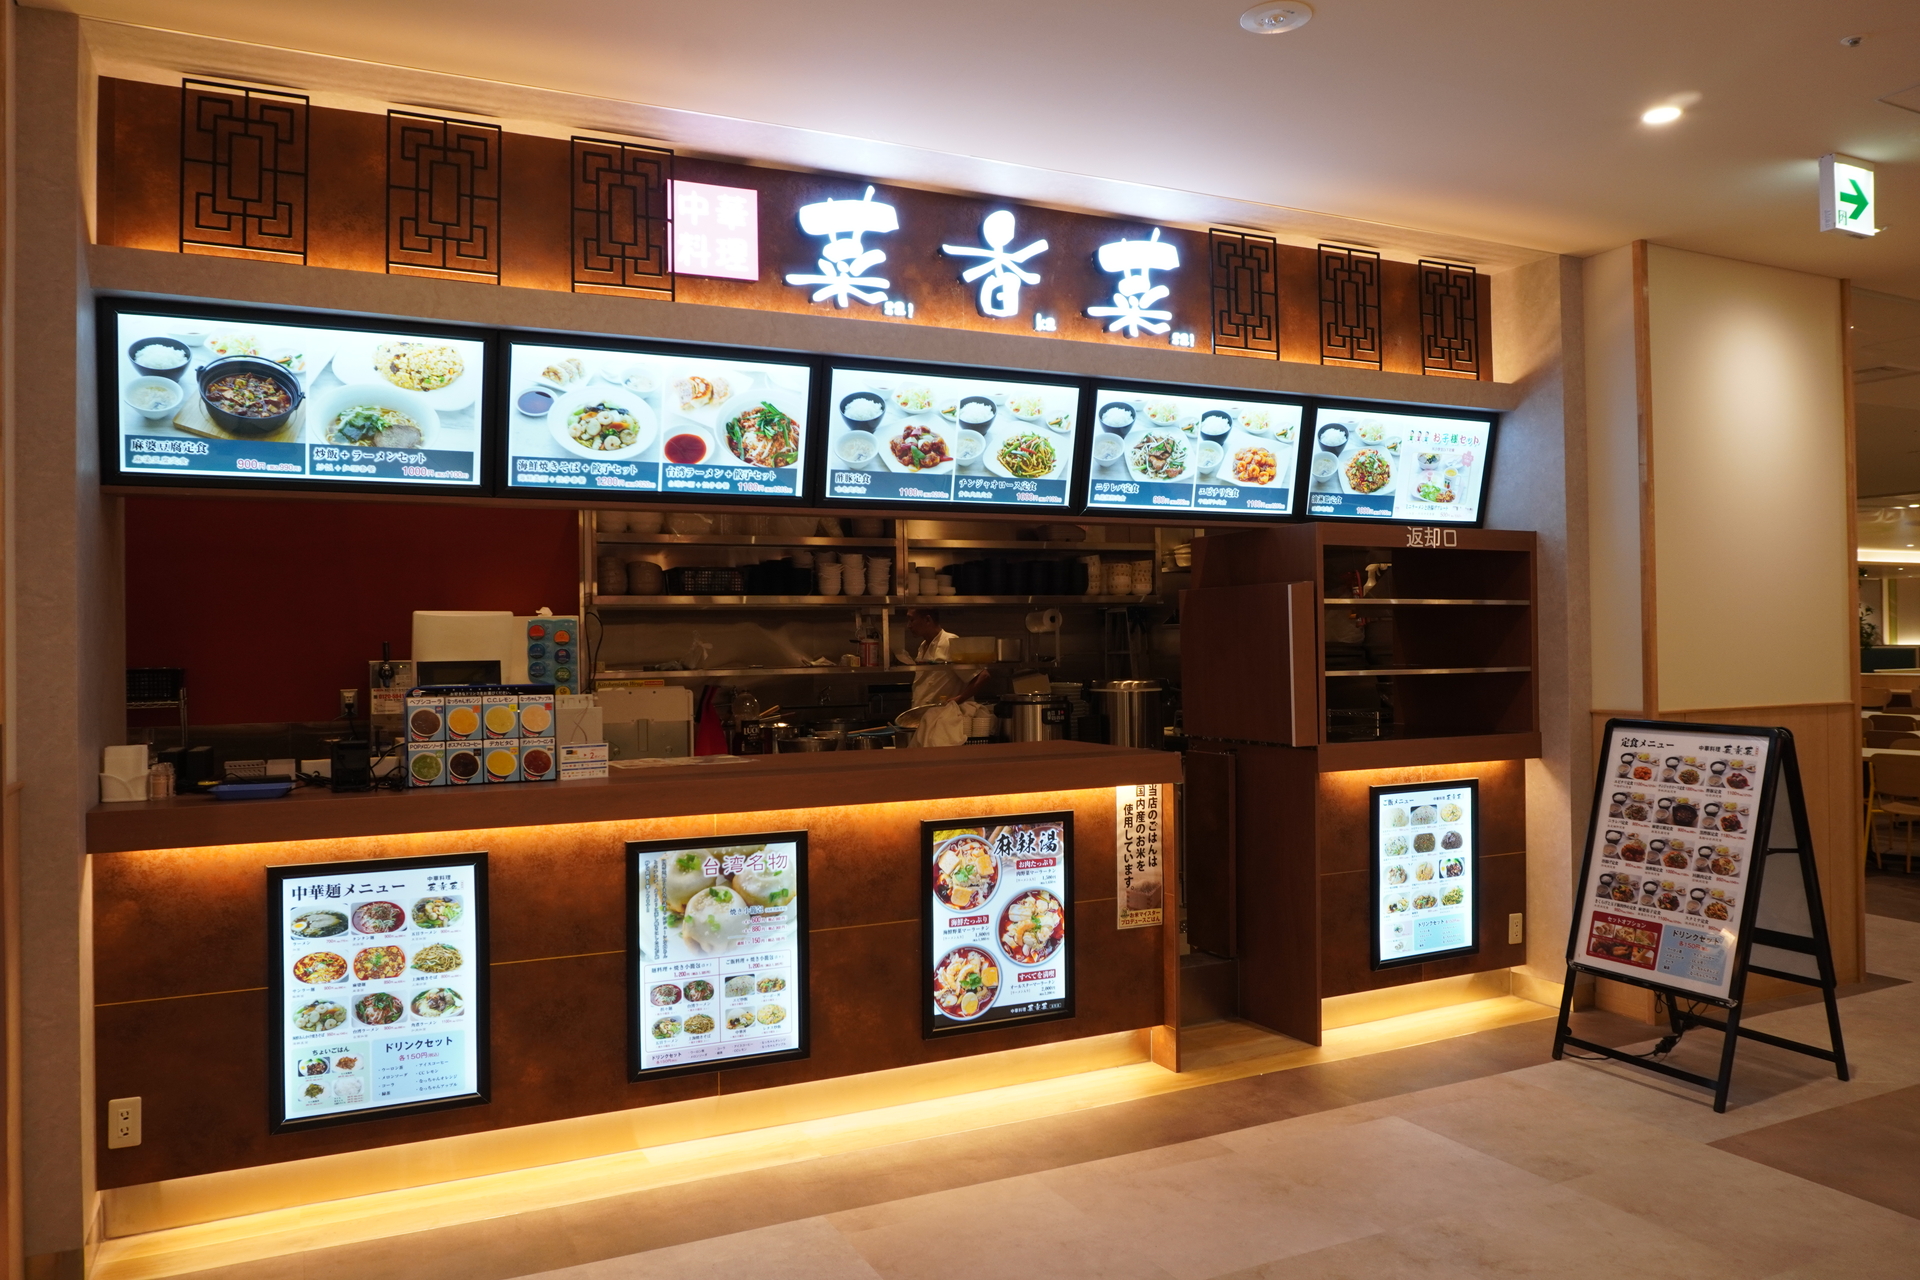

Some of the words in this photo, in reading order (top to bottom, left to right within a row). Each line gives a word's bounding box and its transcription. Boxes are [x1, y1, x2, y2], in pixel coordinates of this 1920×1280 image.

[678, 190, 749, 231] 中華
[131, 439, 209, 455] 麻婆豆腐定食
[1406, 526, 1457, 548] 返却口
[1620, 737, 1675, 749] 定食メニュー
[1136, 785, 1146, 872] 国内産のお米を
[1147, 784, 1157, 867] 当店のごはんは
[994, 830, 1058, 856] 麻辣湯
[1124, 803, 1135, 891] 使用しています。
[702, 853, 789, 877] 台湾名物
[1018, 859, 1054, 868] お肉たっぷり
[291, 882, 406, 902] 中華麺メニュー
[1607, 916, 1647, 928] セットオプション
[1672, 929, 1720, 945] ドリンクセット
[312, 1046, 350, 1056] ちょいごはん
[386, 1036, 453, 1053] ドリンクセット
[652, 1052, 681, 1060] ドリンクセット
